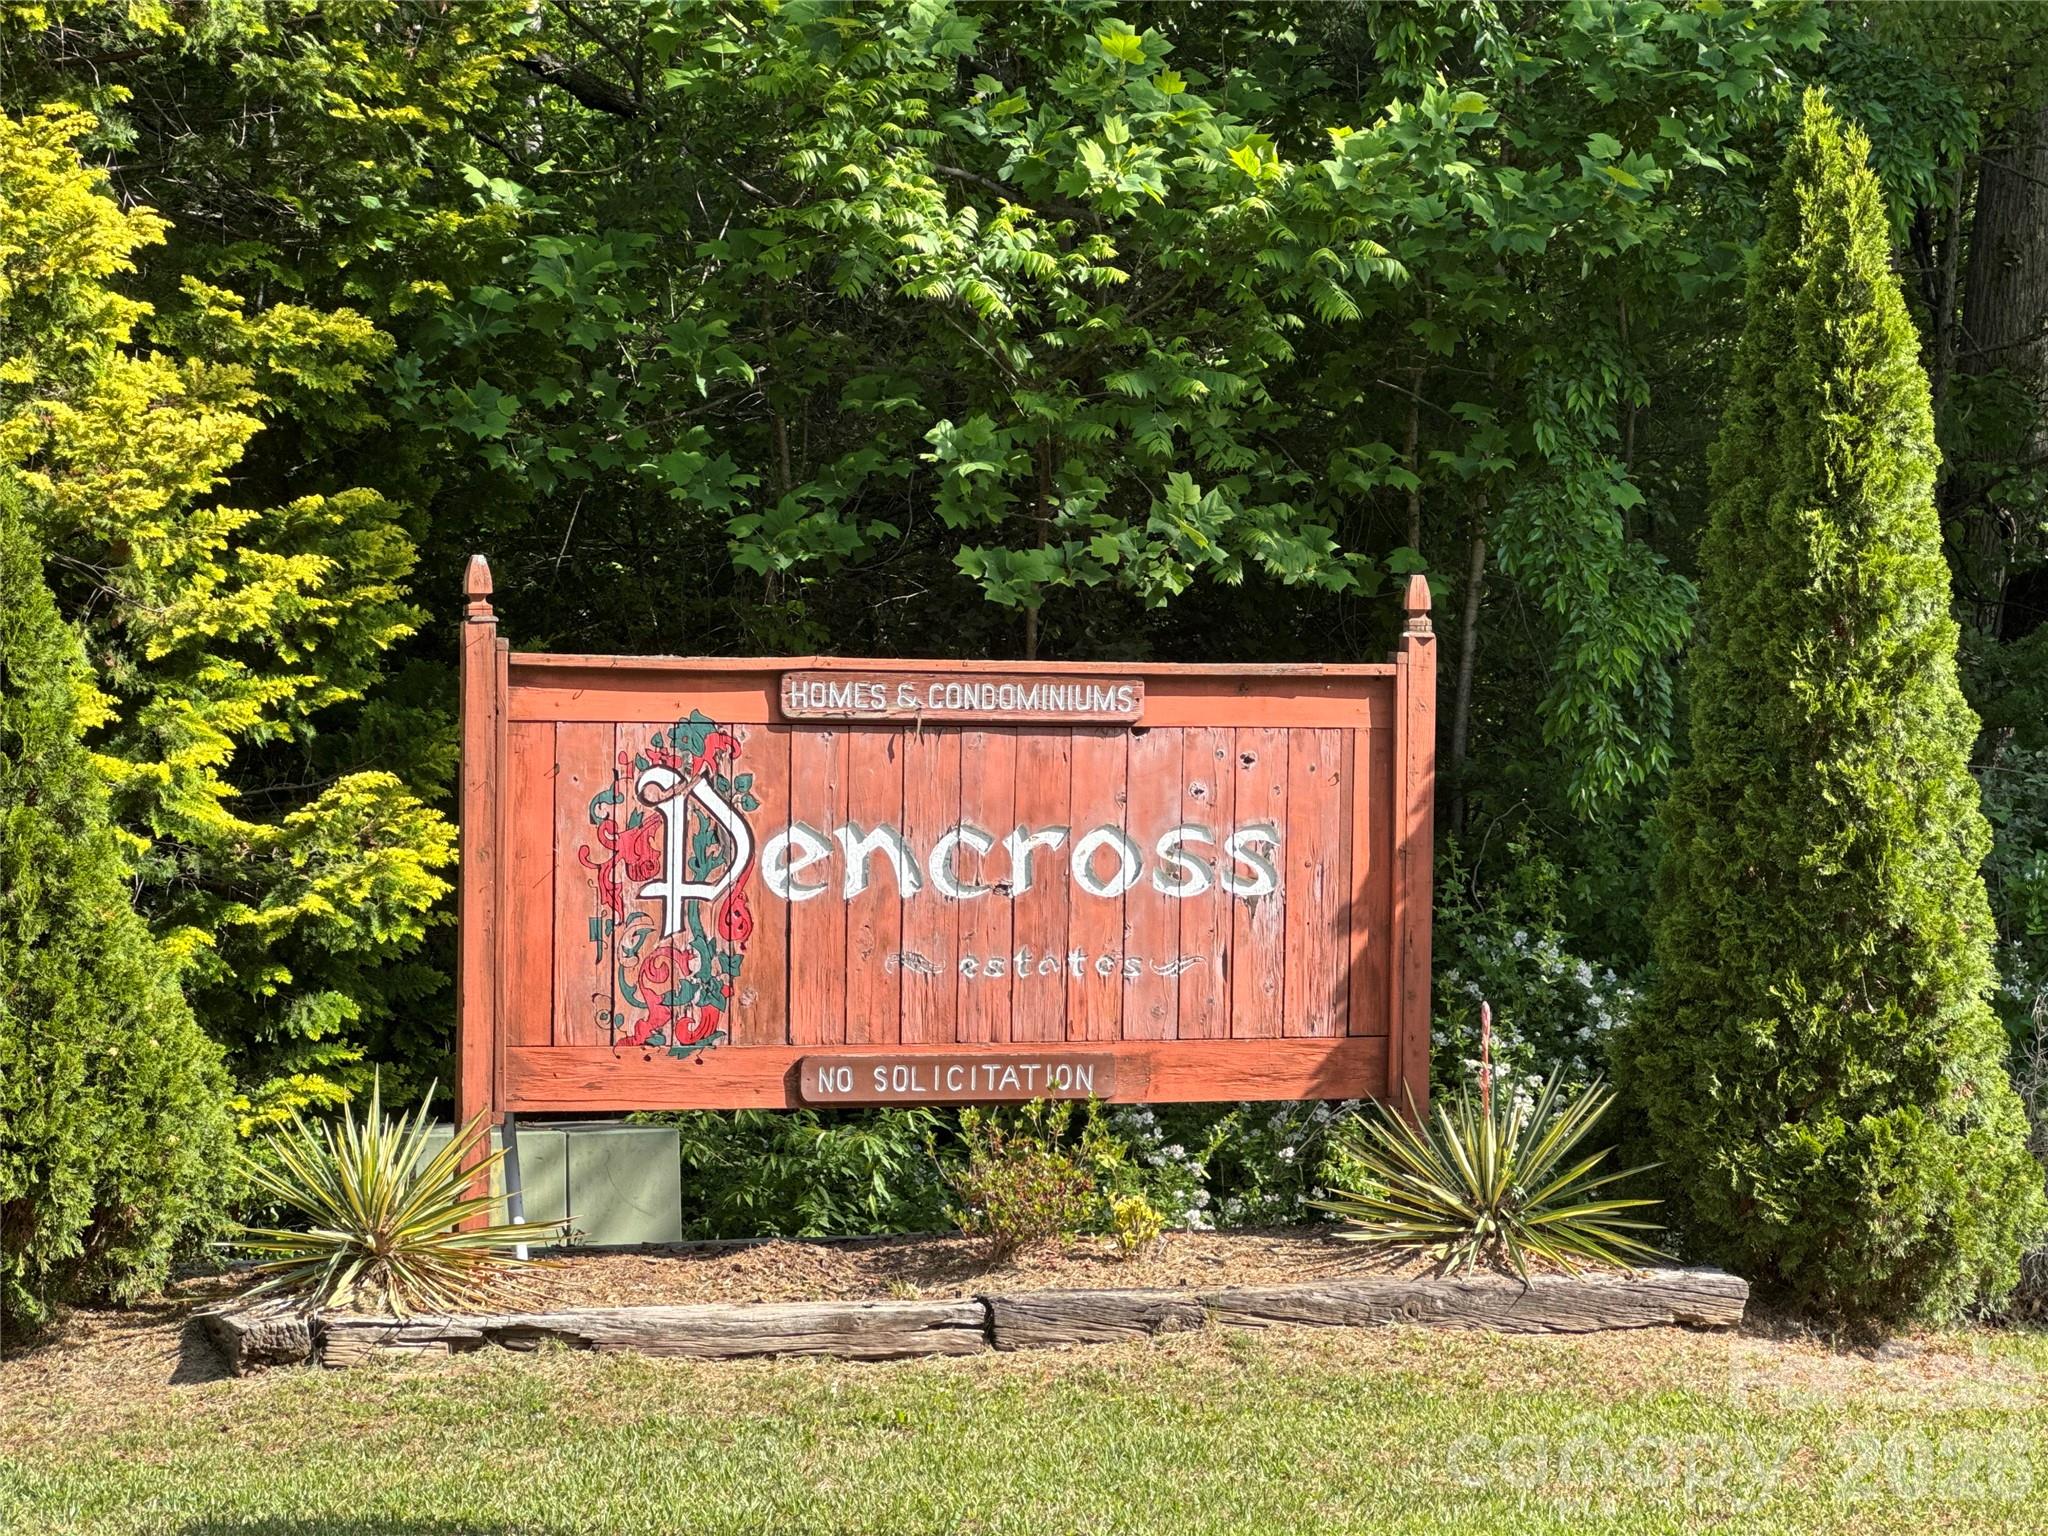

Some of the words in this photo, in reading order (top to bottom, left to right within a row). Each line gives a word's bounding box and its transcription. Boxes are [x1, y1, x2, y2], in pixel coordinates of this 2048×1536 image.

[790, 680, 886, 710] HOMES
[896, 683, 918, 709] &
[927, 683, 1134, 713] CONDOMINIUMS
[635, 766, 1280, 938] Pencross
[959, 947, 1144, 978] estates
[818, 1066, 853, 1093] NO
[874, 1064, 1094, 1093] SOLICITATION
